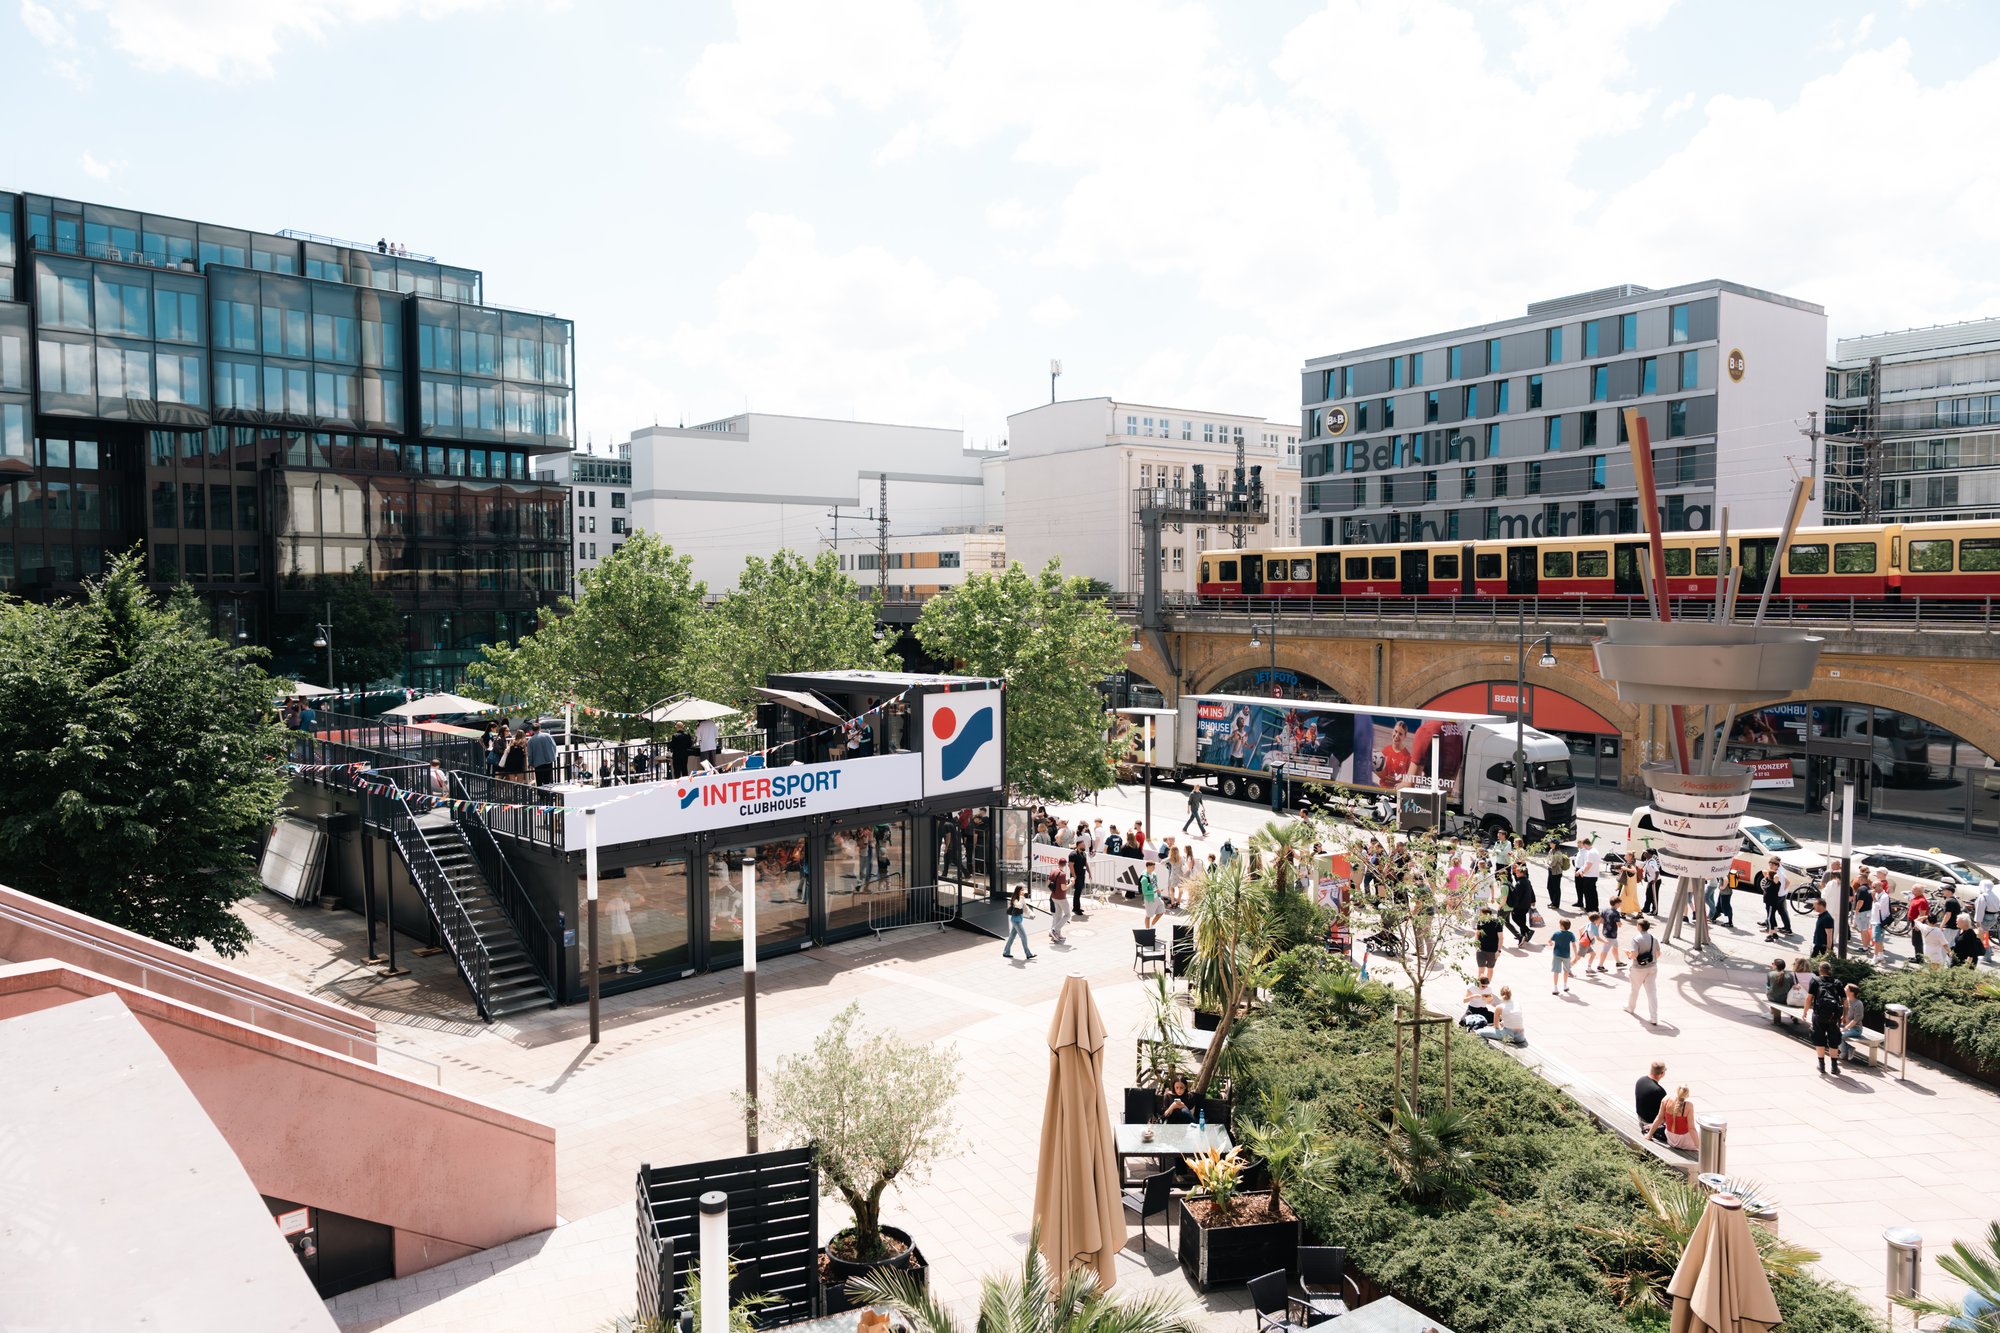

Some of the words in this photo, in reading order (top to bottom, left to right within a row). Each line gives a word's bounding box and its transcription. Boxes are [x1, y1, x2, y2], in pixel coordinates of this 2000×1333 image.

[1327, 414, 1345, 426] B&B
[1352, 430, 1476, 473] Berlin
[1210, 707, 1223, 718] INS
[1757, 762, 1789, 771] KONZEPT
[703, 769, 842, 807] INTERSPORT
[1402, 773, 1455, 789] INTERSORT
[739, 796, 807, 817] CLUBHOUSE
